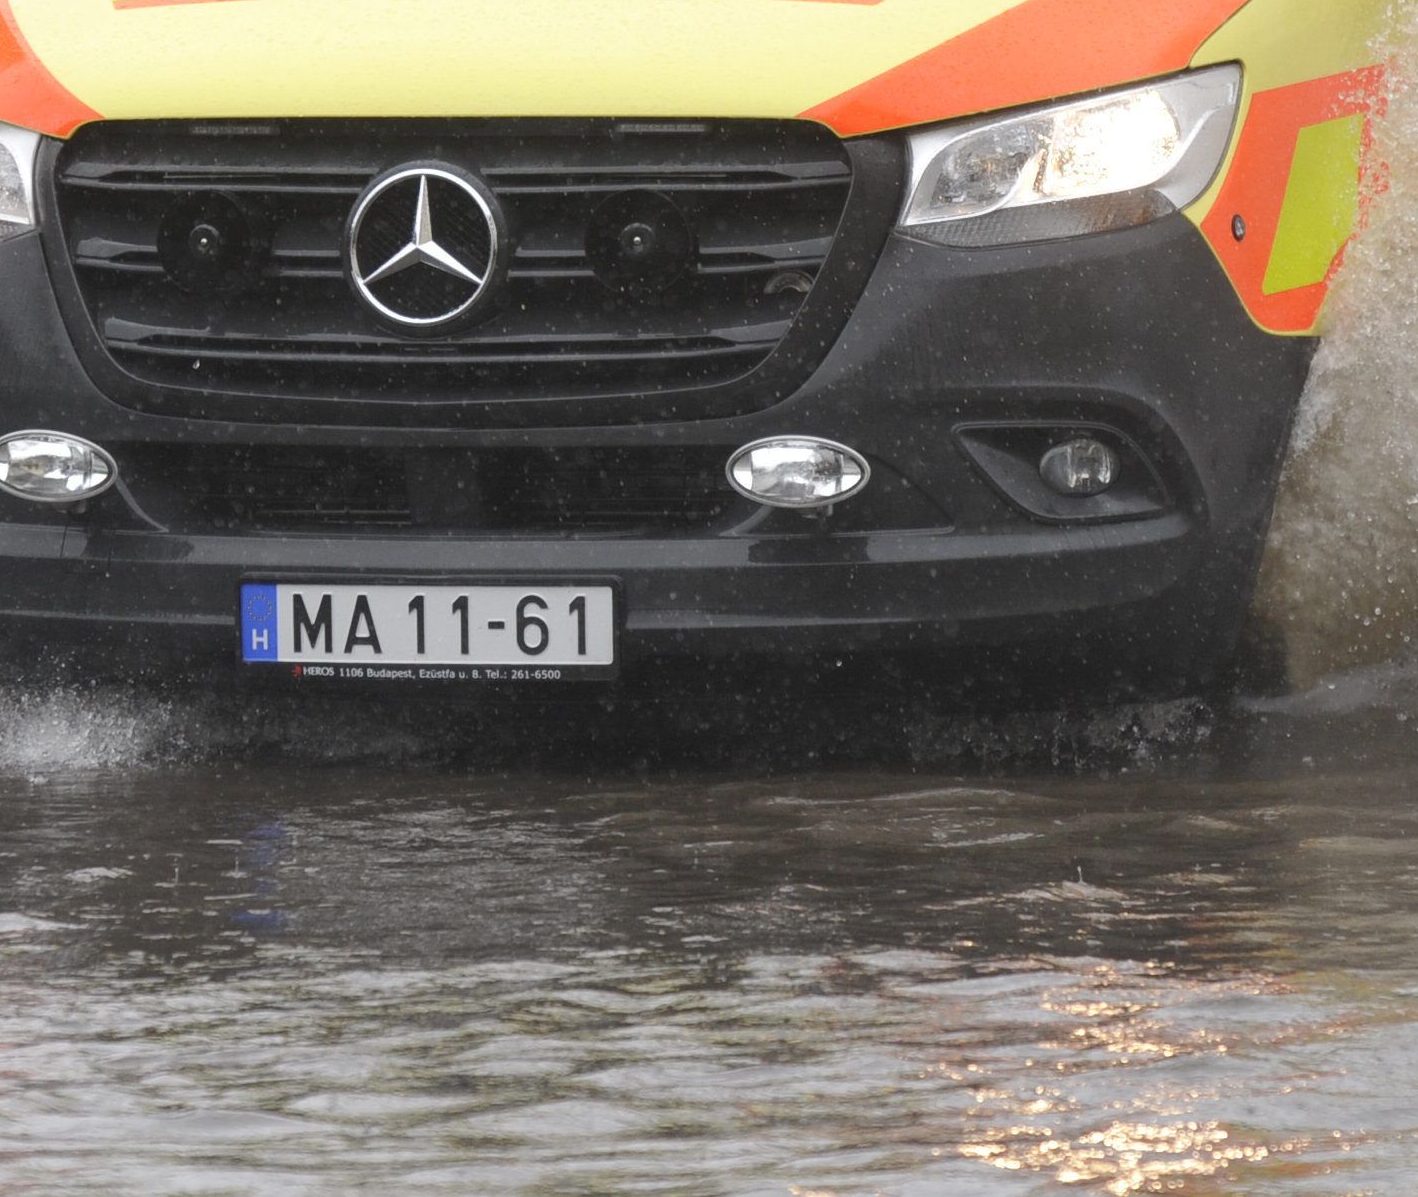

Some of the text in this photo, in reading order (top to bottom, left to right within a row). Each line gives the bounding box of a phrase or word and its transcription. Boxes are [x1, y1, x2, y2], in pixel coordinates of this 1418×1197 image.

[252, 628, 268, 651] H
[302, 666, 335, 677] HEROS
[339, 667, 364, 678] 1106
[366, 667, 416, 680] Budapest,
[511, 669, 562, 680] 261-6500
